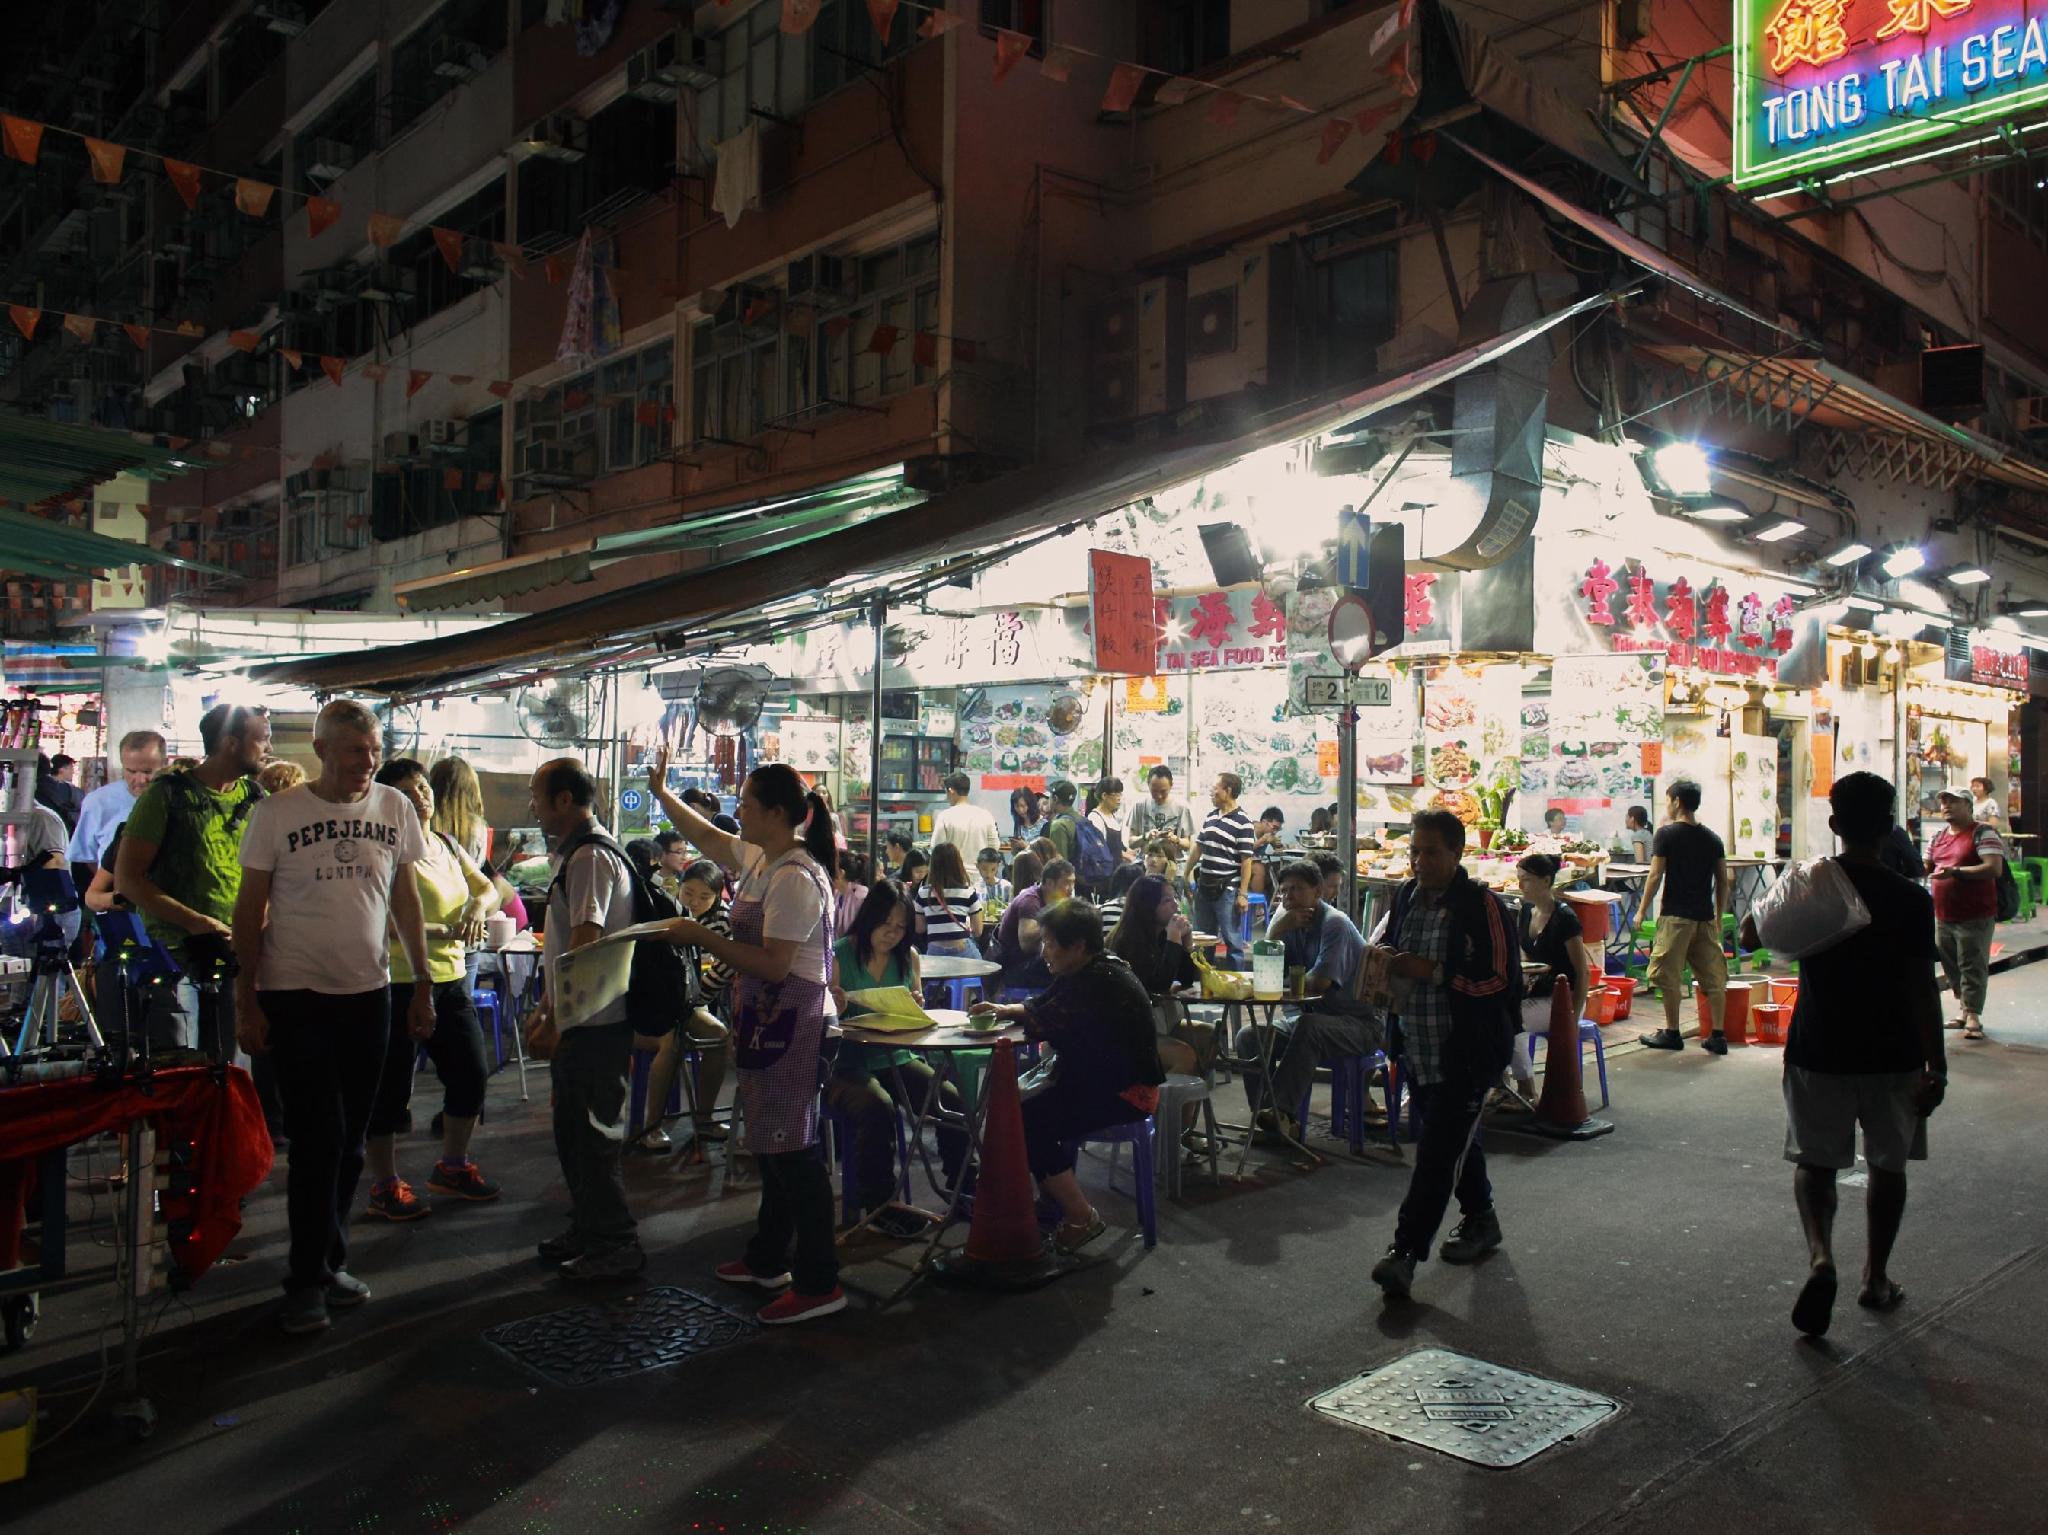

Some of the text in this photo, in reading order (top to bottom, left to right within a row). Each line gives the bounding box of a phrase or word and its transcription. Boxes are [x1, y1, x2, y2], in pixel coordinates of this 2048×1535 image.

[1762, 17, 2047, 145] TONG TAI SEA
[1190, 650, 1219, 668] SEA
[1224, 646, 1264, 665] FOOD
[1327, 682, 1337, 700] 2
[1374, 682, 1388, 700] 12
[316, 865, 373, 881] LONDON
